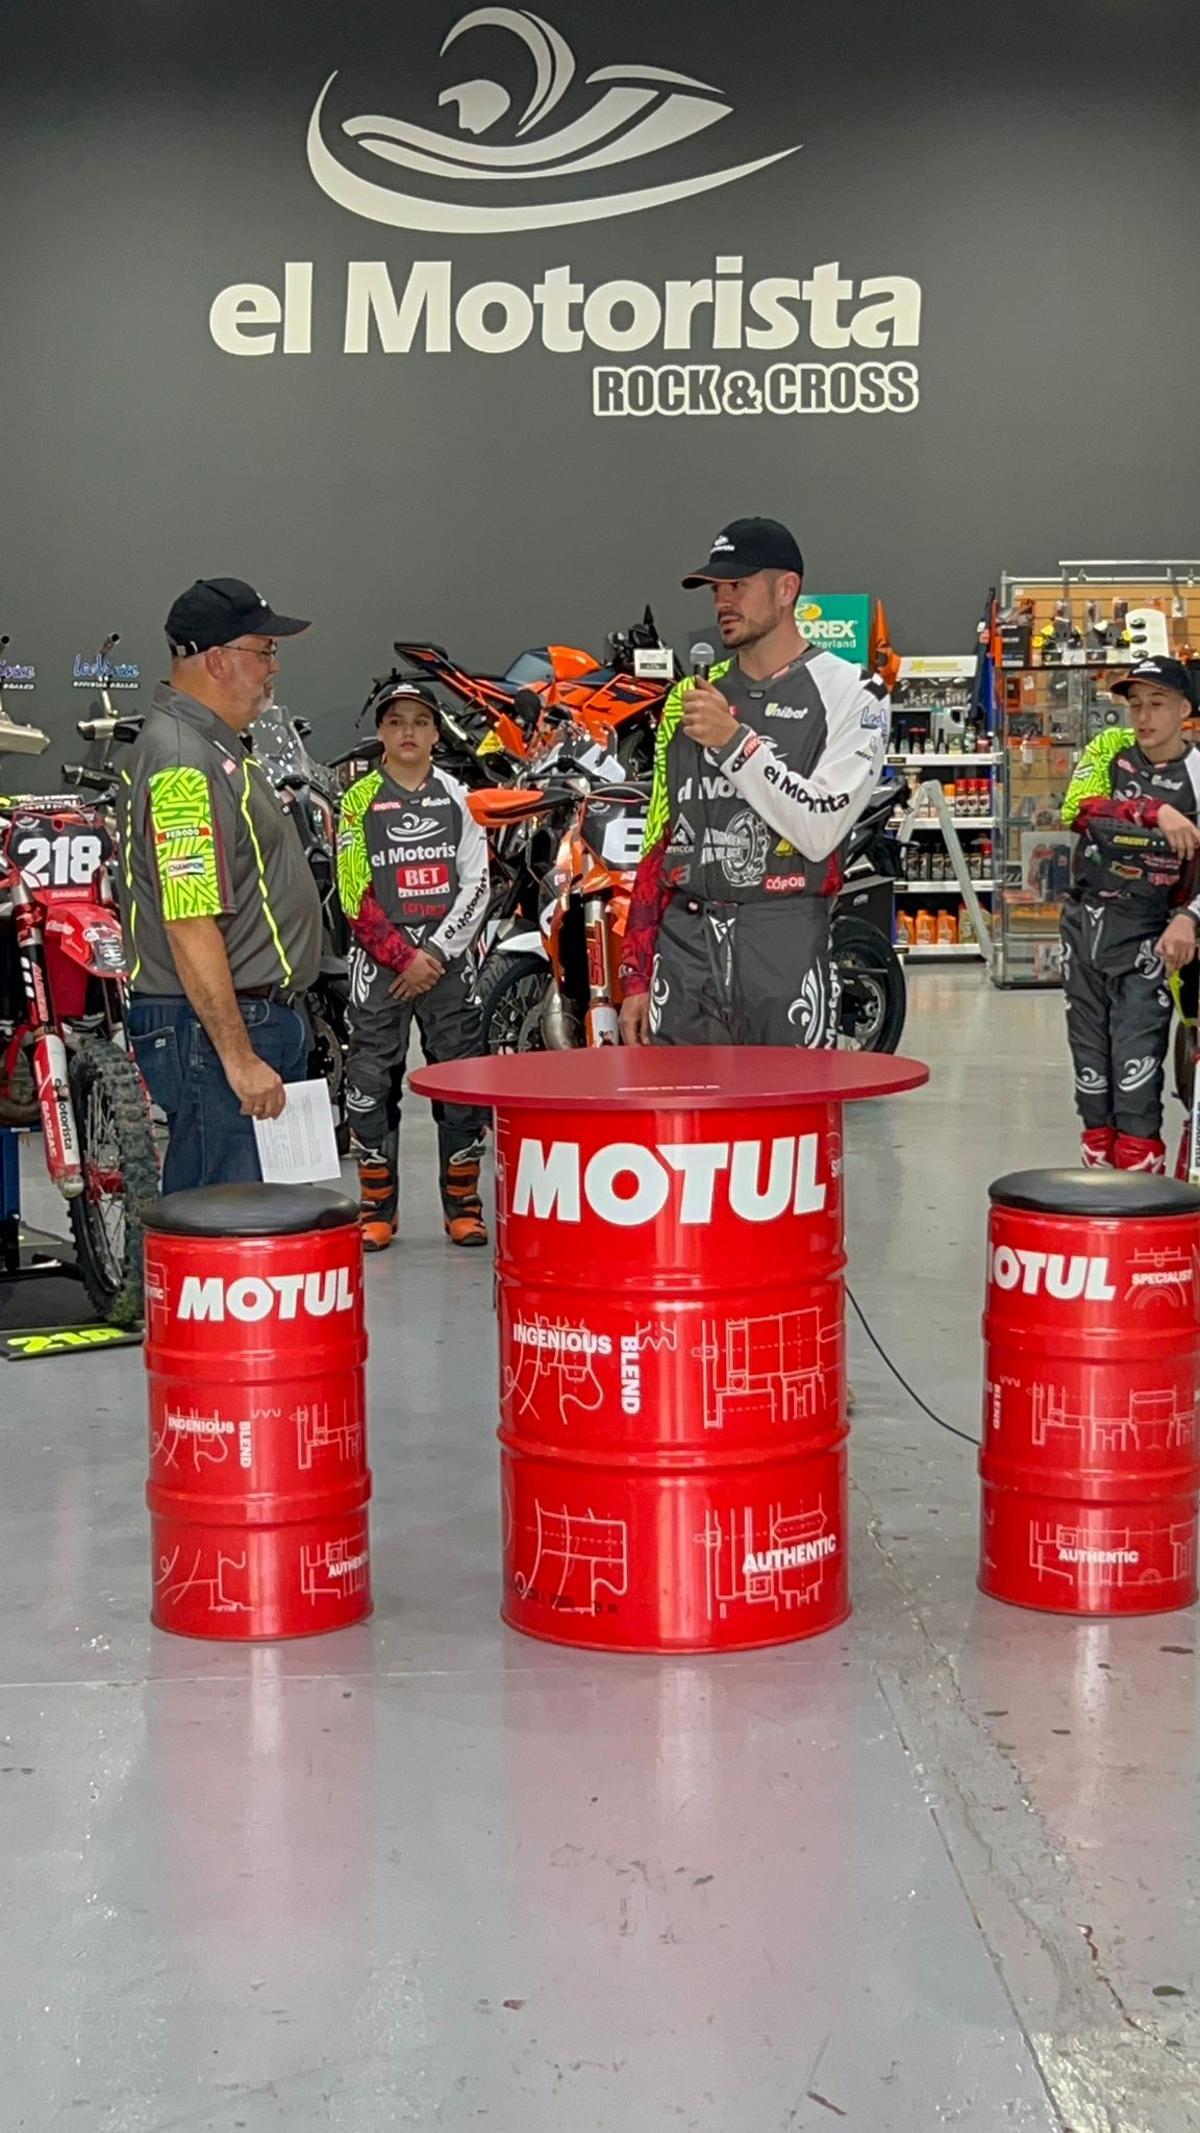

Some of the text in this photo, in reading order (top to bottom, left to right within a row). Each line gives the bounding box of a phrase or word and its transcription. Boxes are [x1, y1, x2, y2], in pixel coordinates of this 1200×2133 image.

[209, 256, 922, 355] el Motorista
[764, 765, 782, 786] el
[17, 835, 102, 888] 218
[371, 850, 386, 867] el
[404, 867, 441, 887] BET
[512, 1132, 827, 1227] MOTUL
[176, 1266, 354, 1323] MOTUL
[1131, 1269, 1193, 1286] SPECIALIST
[513, 1322, 612, 1354] INGENIOUS
[620, 1336, 641, 1415] BLEND
[168, 1415, 235, 1435] INGENIOUS
[239, 1420, 252, 1469] BLEND
[742, 1534, 837, 1573] AUTHENTIC
[1058, 1549, 1139, 1564] AUTHENTIC
